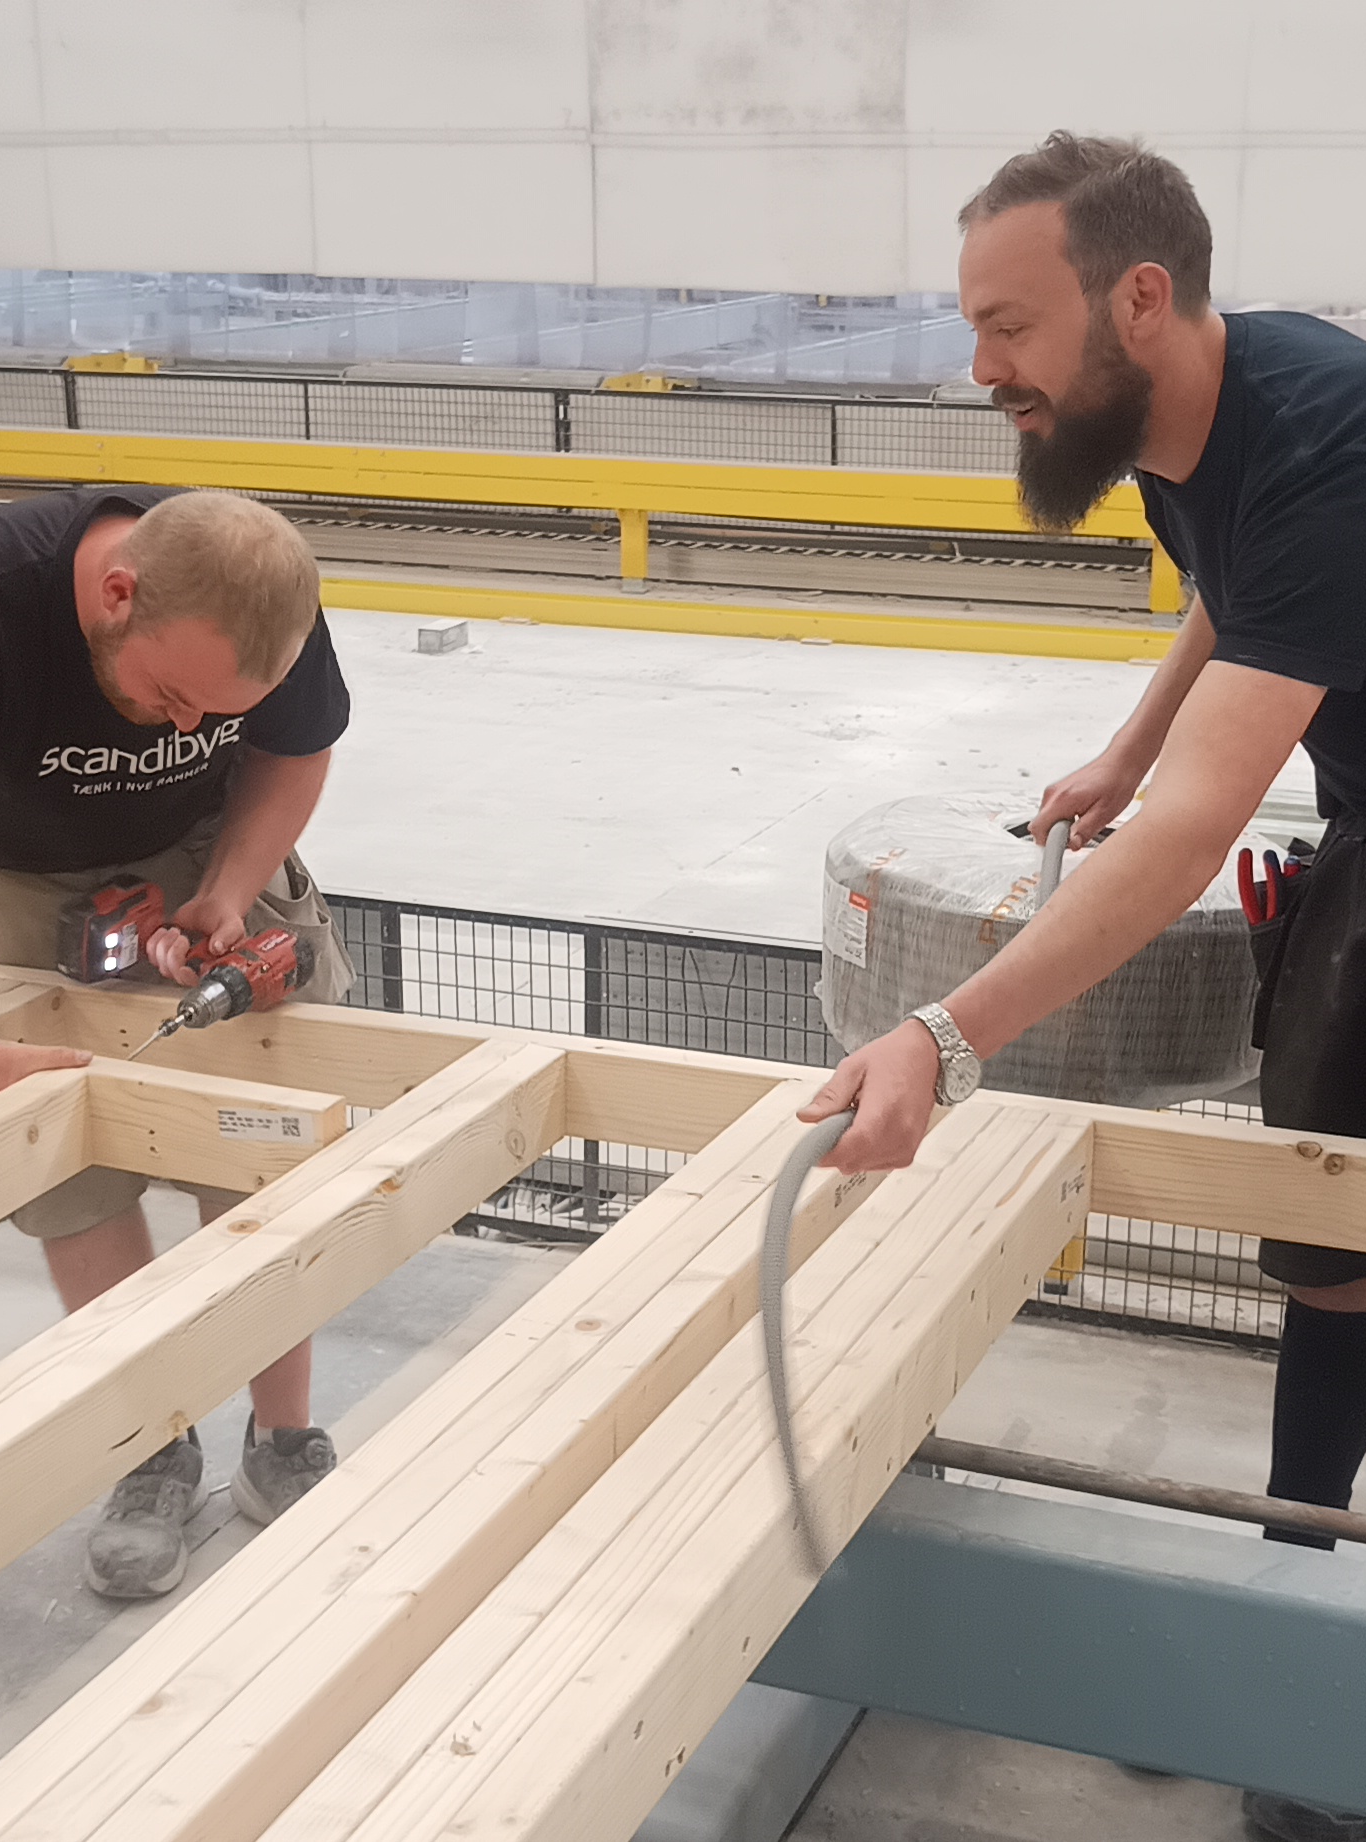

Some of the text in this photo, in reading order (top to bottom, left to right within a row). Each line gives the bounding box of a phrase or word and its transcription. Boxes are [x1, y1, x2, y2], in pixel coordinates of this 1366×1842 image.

[38, 716, 245, 777] scandibyg
[72, 781, 112, 796] TÆNK
[125, 779, 154, 793] NYE
[156, 762, 209, 788] RAMMER
